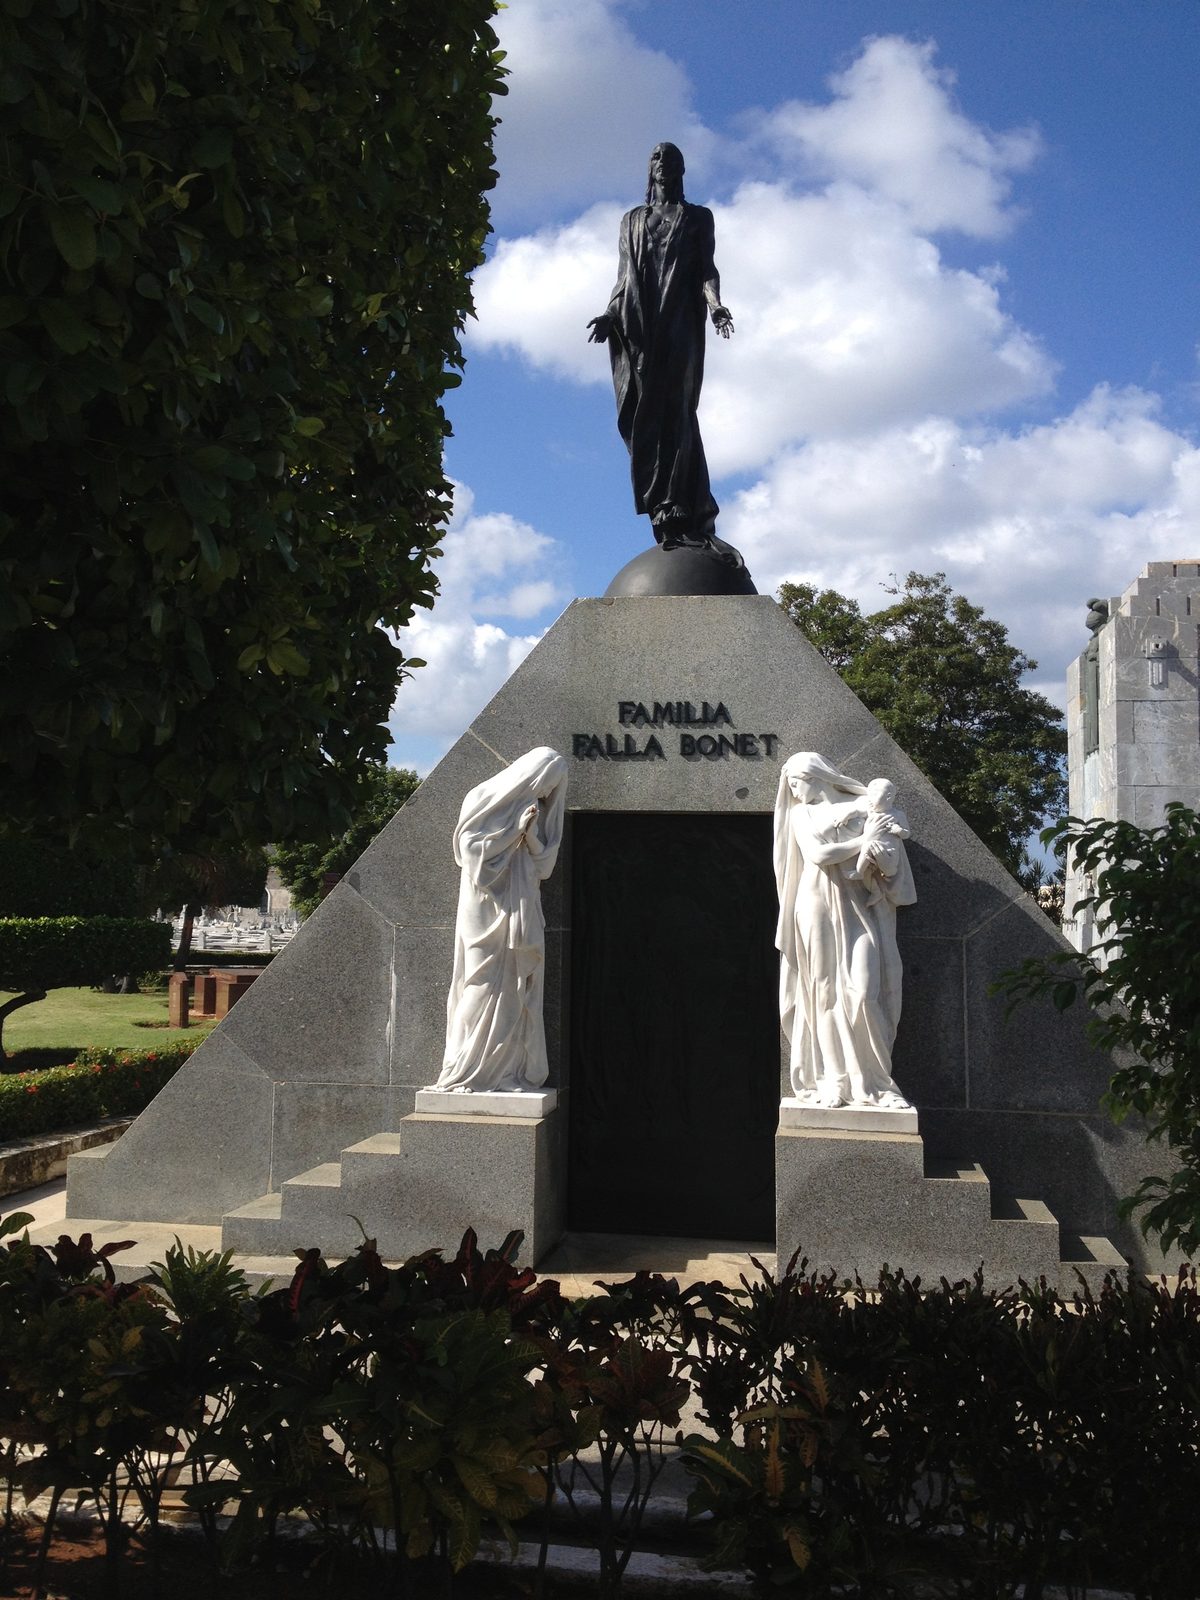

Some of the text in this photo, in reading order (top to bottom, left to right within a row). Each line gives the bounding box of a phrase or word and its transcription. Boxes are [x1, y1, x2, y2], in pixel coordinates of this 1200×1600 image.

[618, 701, 733, 725] FAMILIA
[572, 733, 779, 757] FALLA BONET
